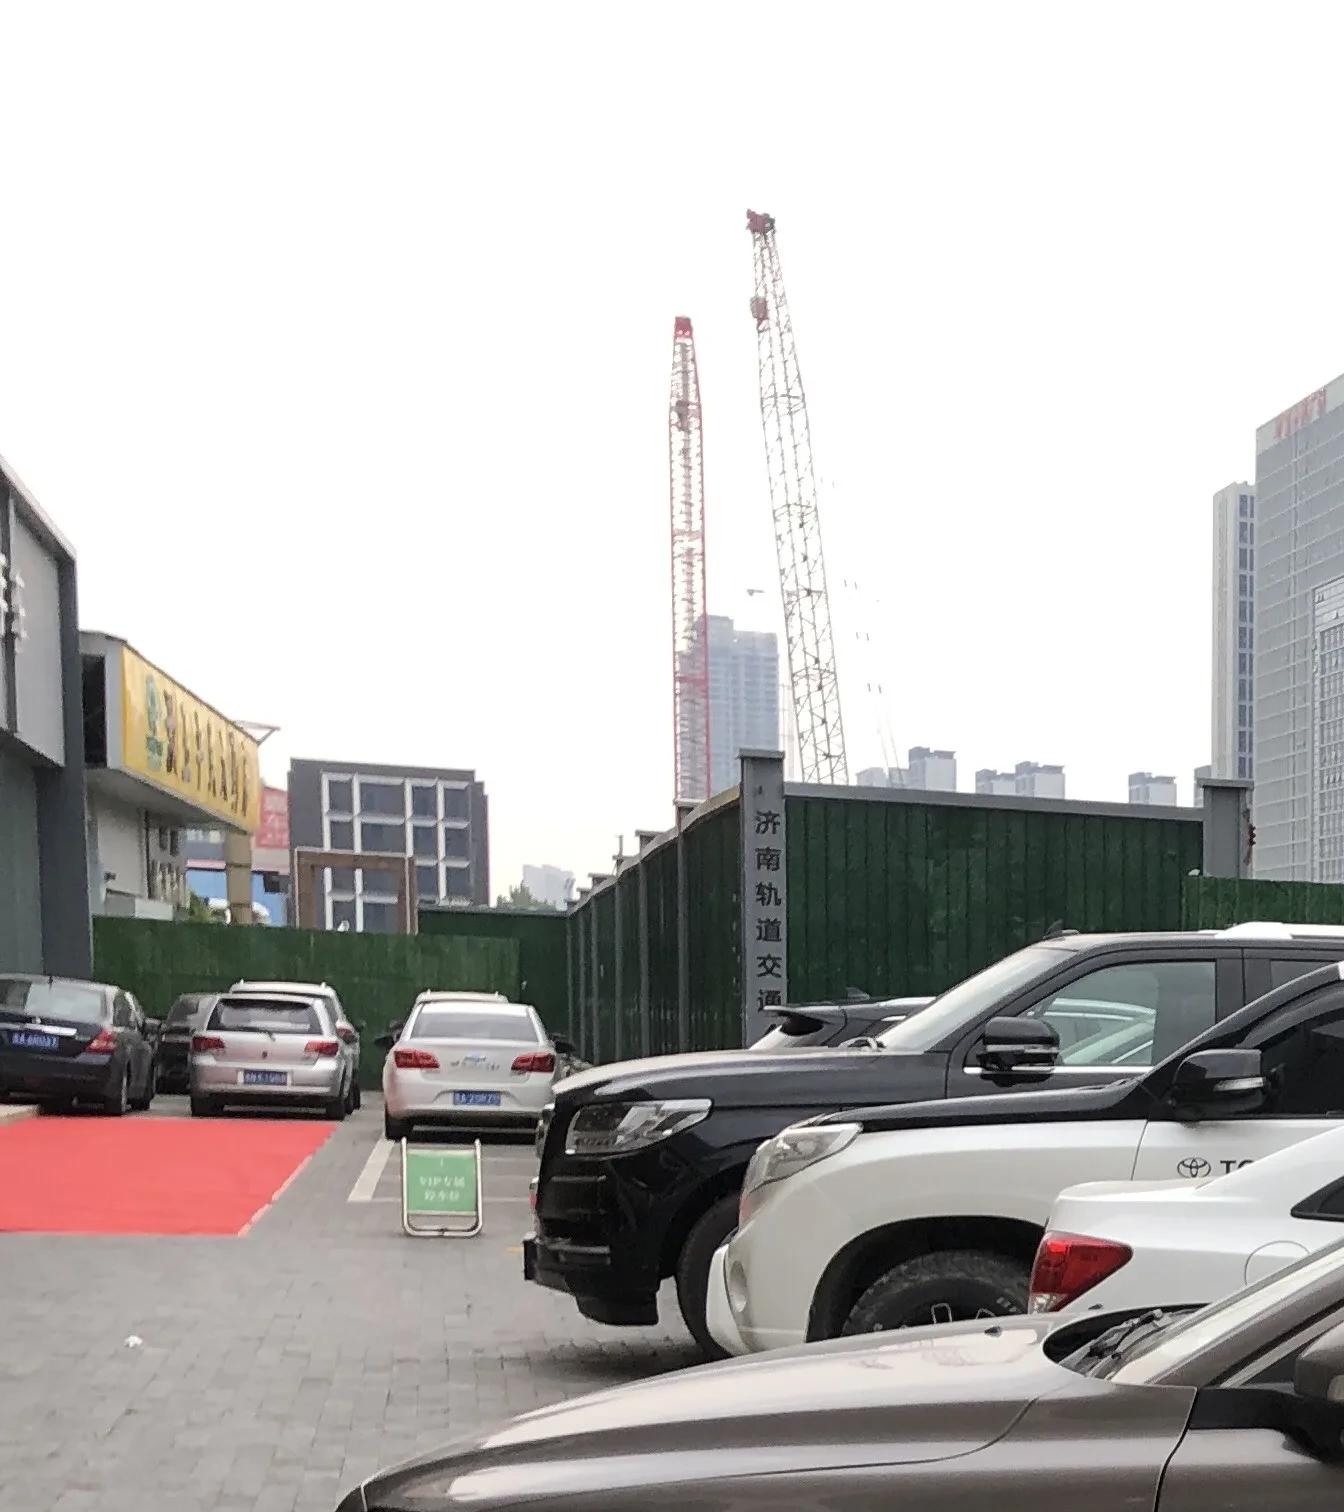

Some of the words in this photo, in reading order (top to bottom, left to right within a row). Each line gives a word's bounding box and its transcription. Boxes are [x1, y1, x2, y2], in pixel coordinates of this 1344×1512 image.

[755, 810, 783, 1011] 济南轨道交通
